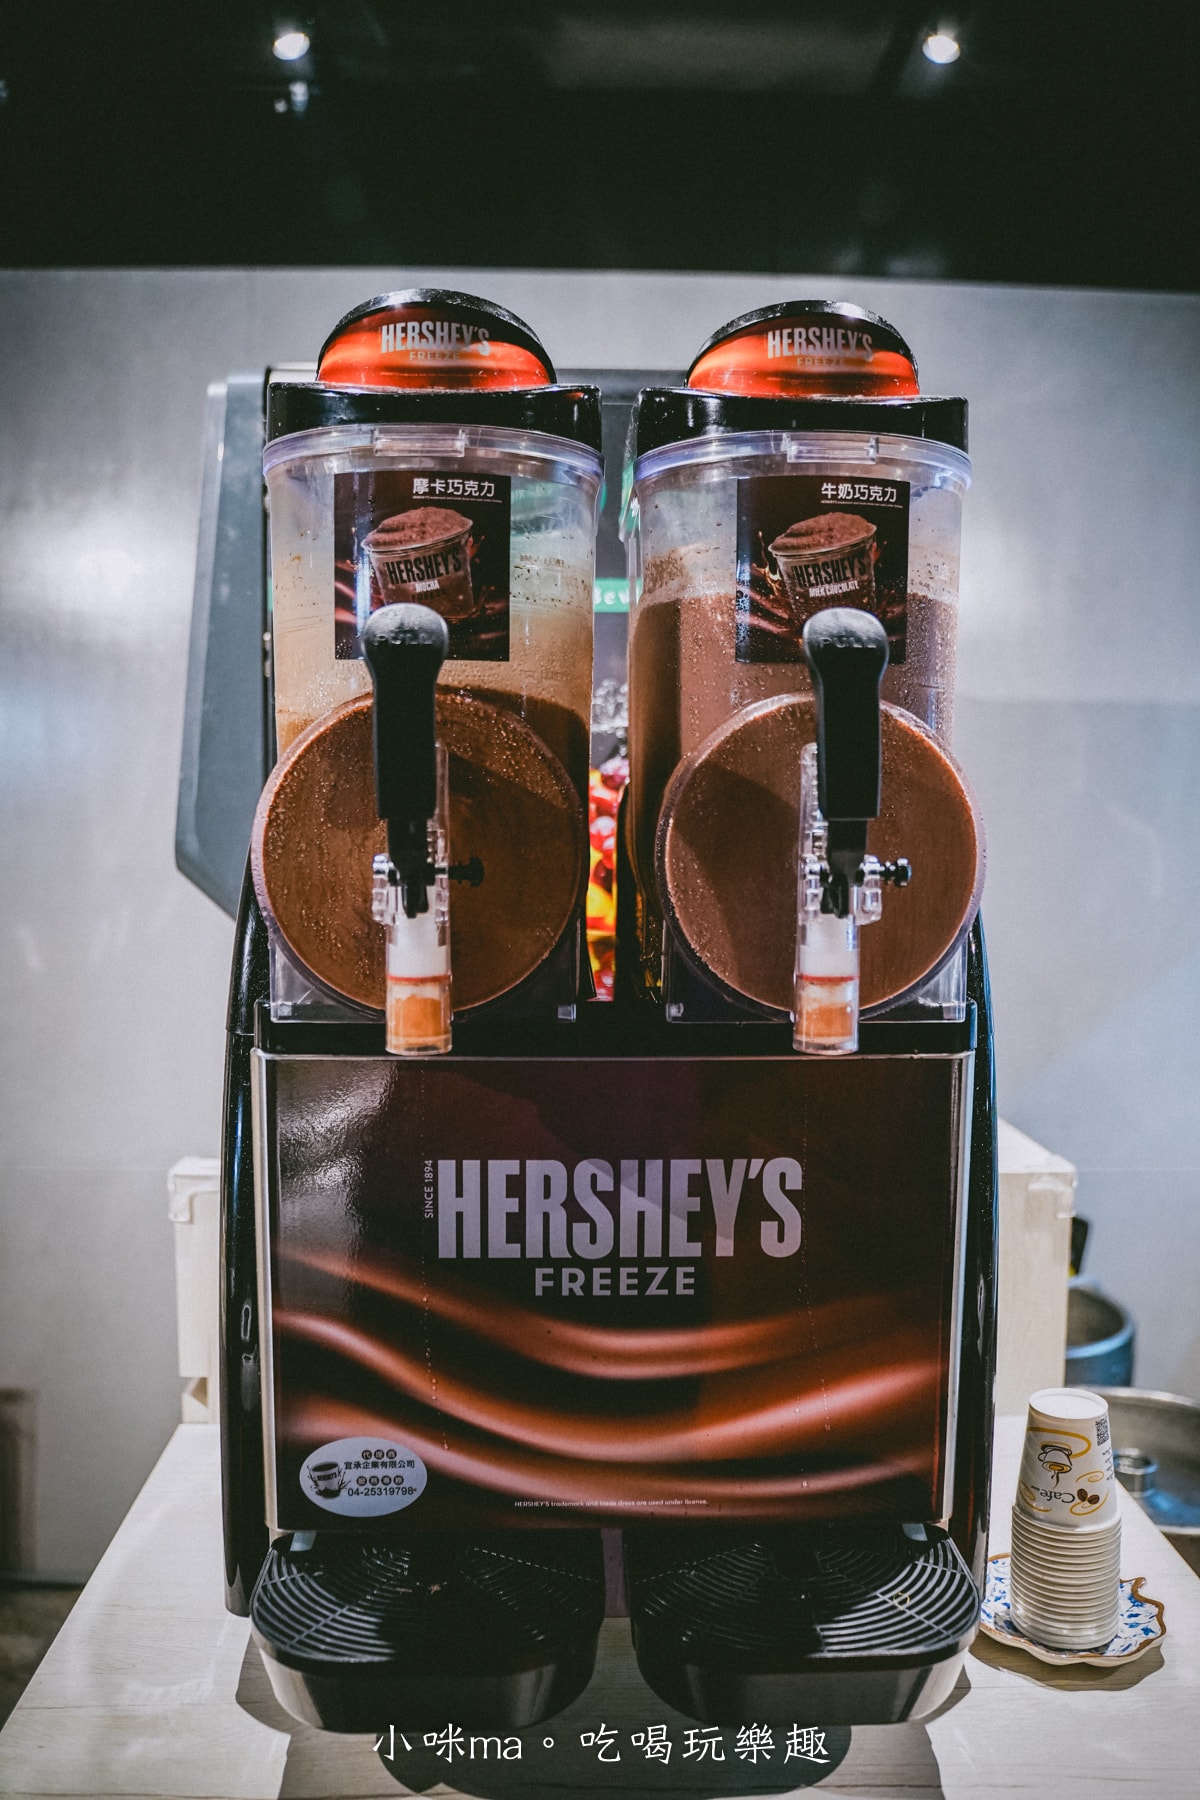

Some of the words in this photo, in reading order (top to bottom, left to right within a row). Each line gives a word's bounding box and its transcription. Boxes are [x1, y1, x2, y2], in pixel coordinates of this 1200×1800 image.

[381, 321, 490, 356] HERSHEY'S
[767, 327, 874, 362] HERSHEY'S
[409, 350, 461, 361] FREEZE
[797, 356, 847, 367] FREEZE
[412, 477, 496, 497] 摩卡巧克力
[821, 482, 897, 502] 牛奶巧克力
[386, 550, 462, 585] HERSHEY'S
[793, 555, 866, 588] HERSHEY'S
[415, 579, 440, 593] MOCHA
[826, 580, 860, 595] CHOCOLATE
[424, 1159, 434, 1183] 1894
[424, 1186, 434, 1219] SINCE
[437, 1157, 802, 1260] HERSHEY'S
[535, 1267, 695, 1297] FREEZE
[347, 1487, 414, 1496] 04-25319798
